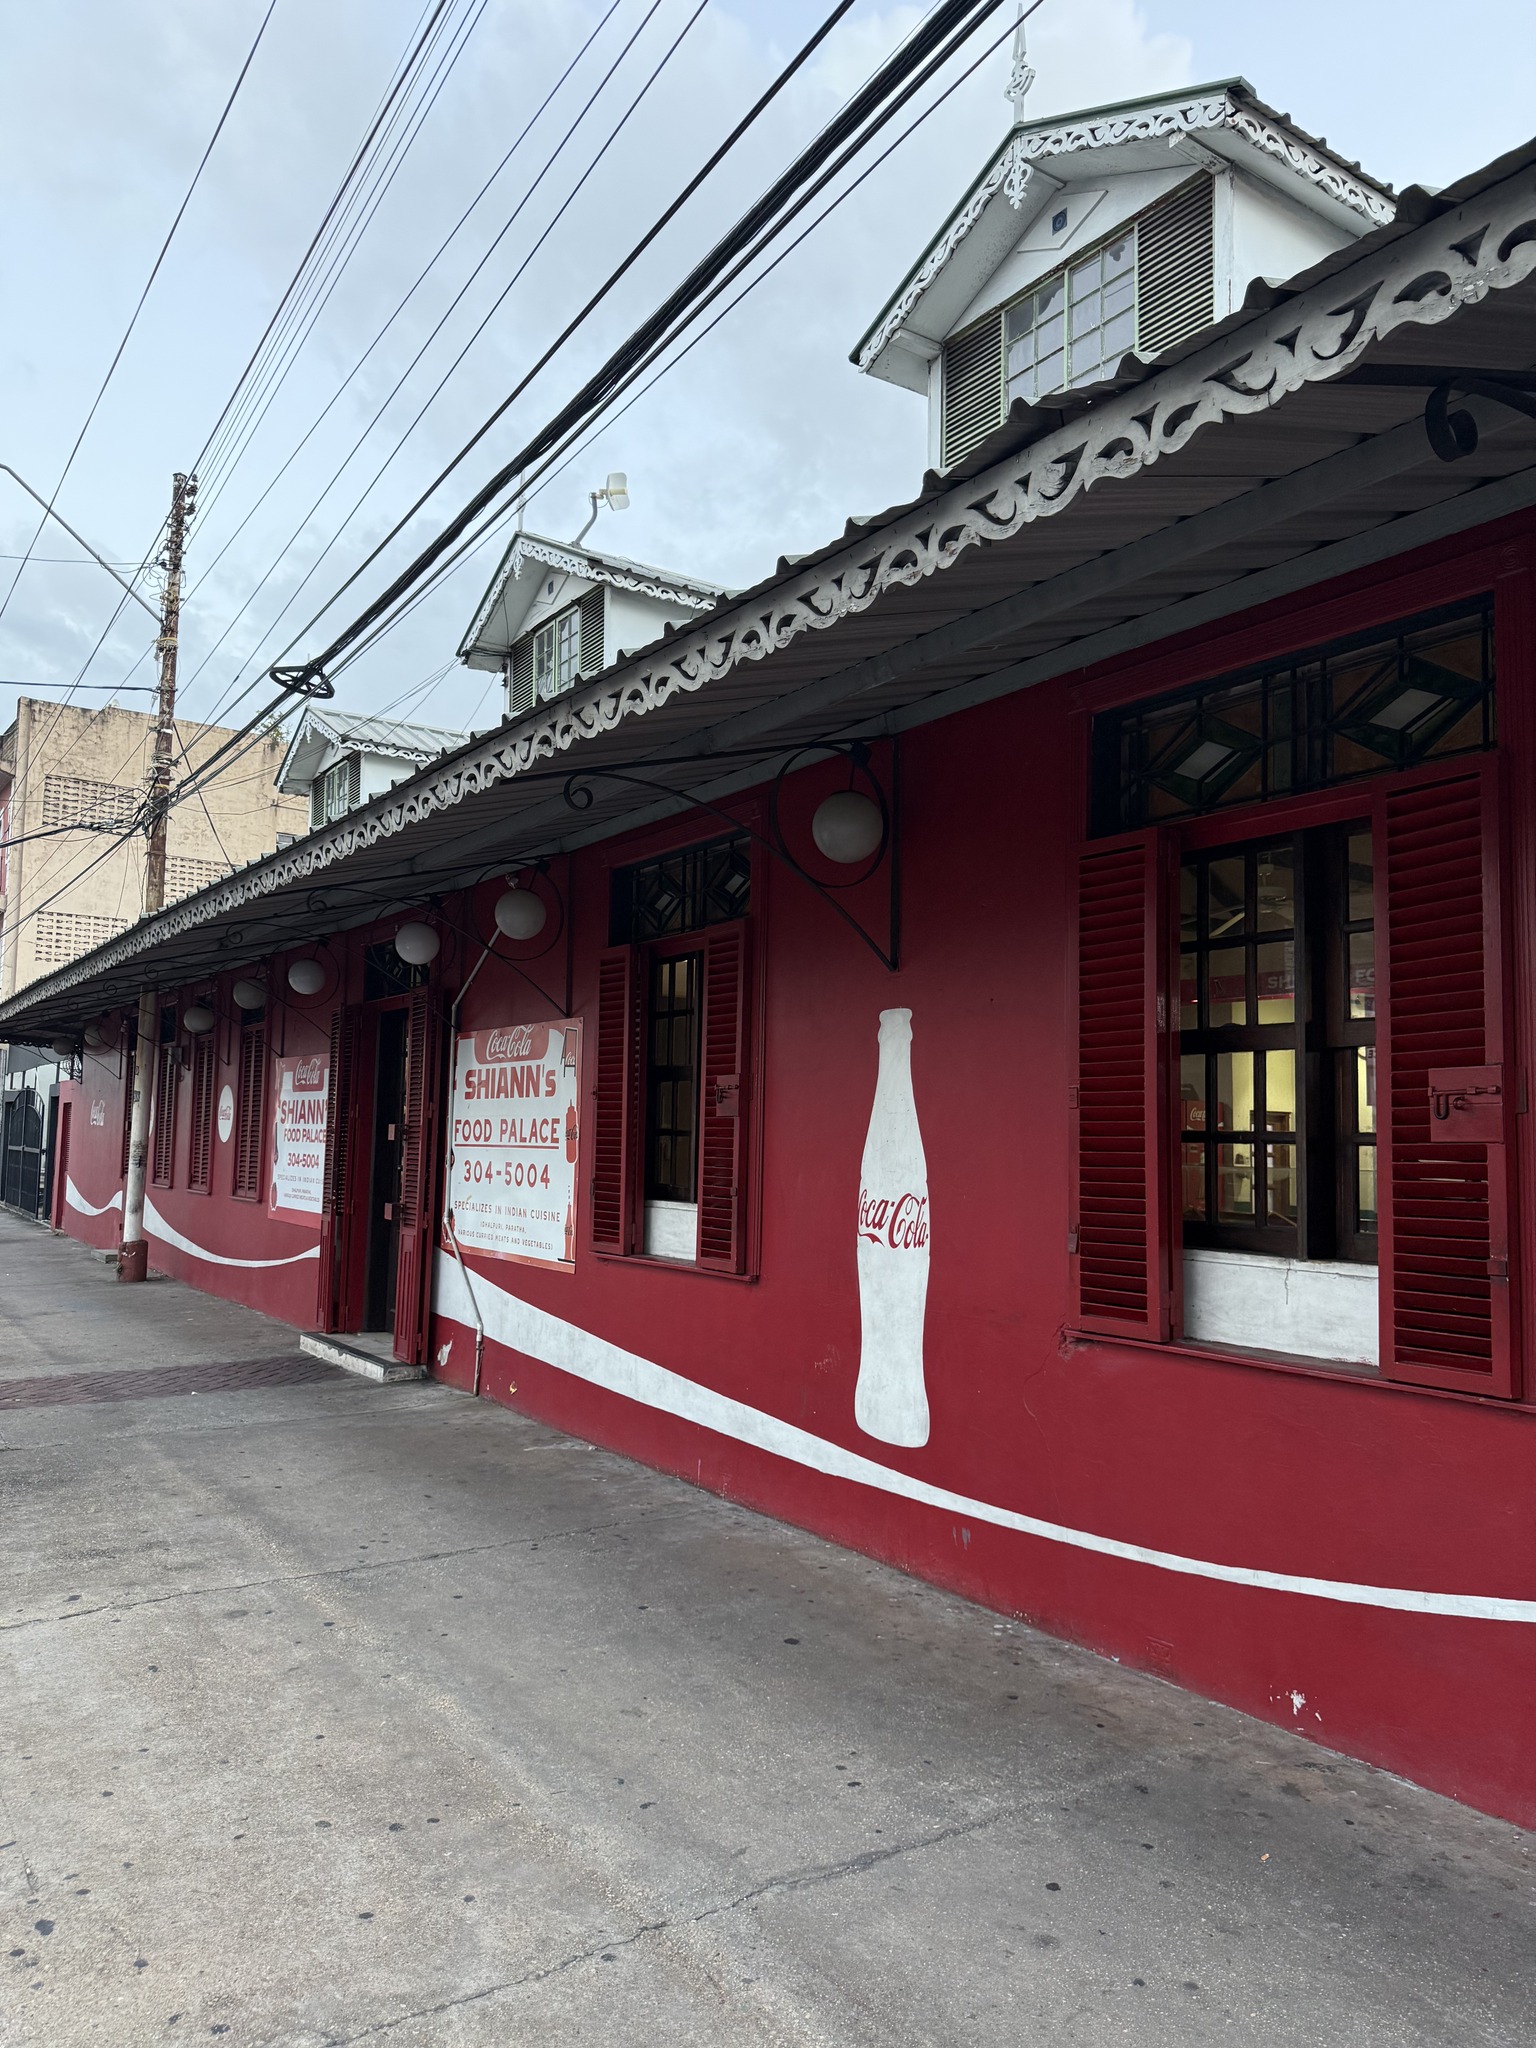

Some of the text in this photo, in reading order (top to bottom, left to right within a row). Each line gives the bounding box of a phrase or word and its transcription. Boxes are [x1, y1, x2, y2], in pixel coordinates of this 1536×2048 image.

[486, 1024, 535, 1061] Coca-Cola
[280, 1099, 328, 1125] SHIANN'
[284, 1128, 301, 1142] FOOD
[454, 1118, 493, 1143] FOOD
[499, 1117, 561, 1144] PALACE
[287, 1153, 320, 1168] 304-5004
[463, 1160, 550, 1190] 304-5004
[454, 1200, 561, 1222] SPECIALIZES IN INDIAN CUISINE
[858, 1188, 929, 1250] Coca-Cola
[458, 1229, 475, 1238] VARIOUS
[476, 1231, 494, 1241] CURRIED
[495, 1234, 509, 1243] MEATS
[511, 1236, 520, 1245] AND
